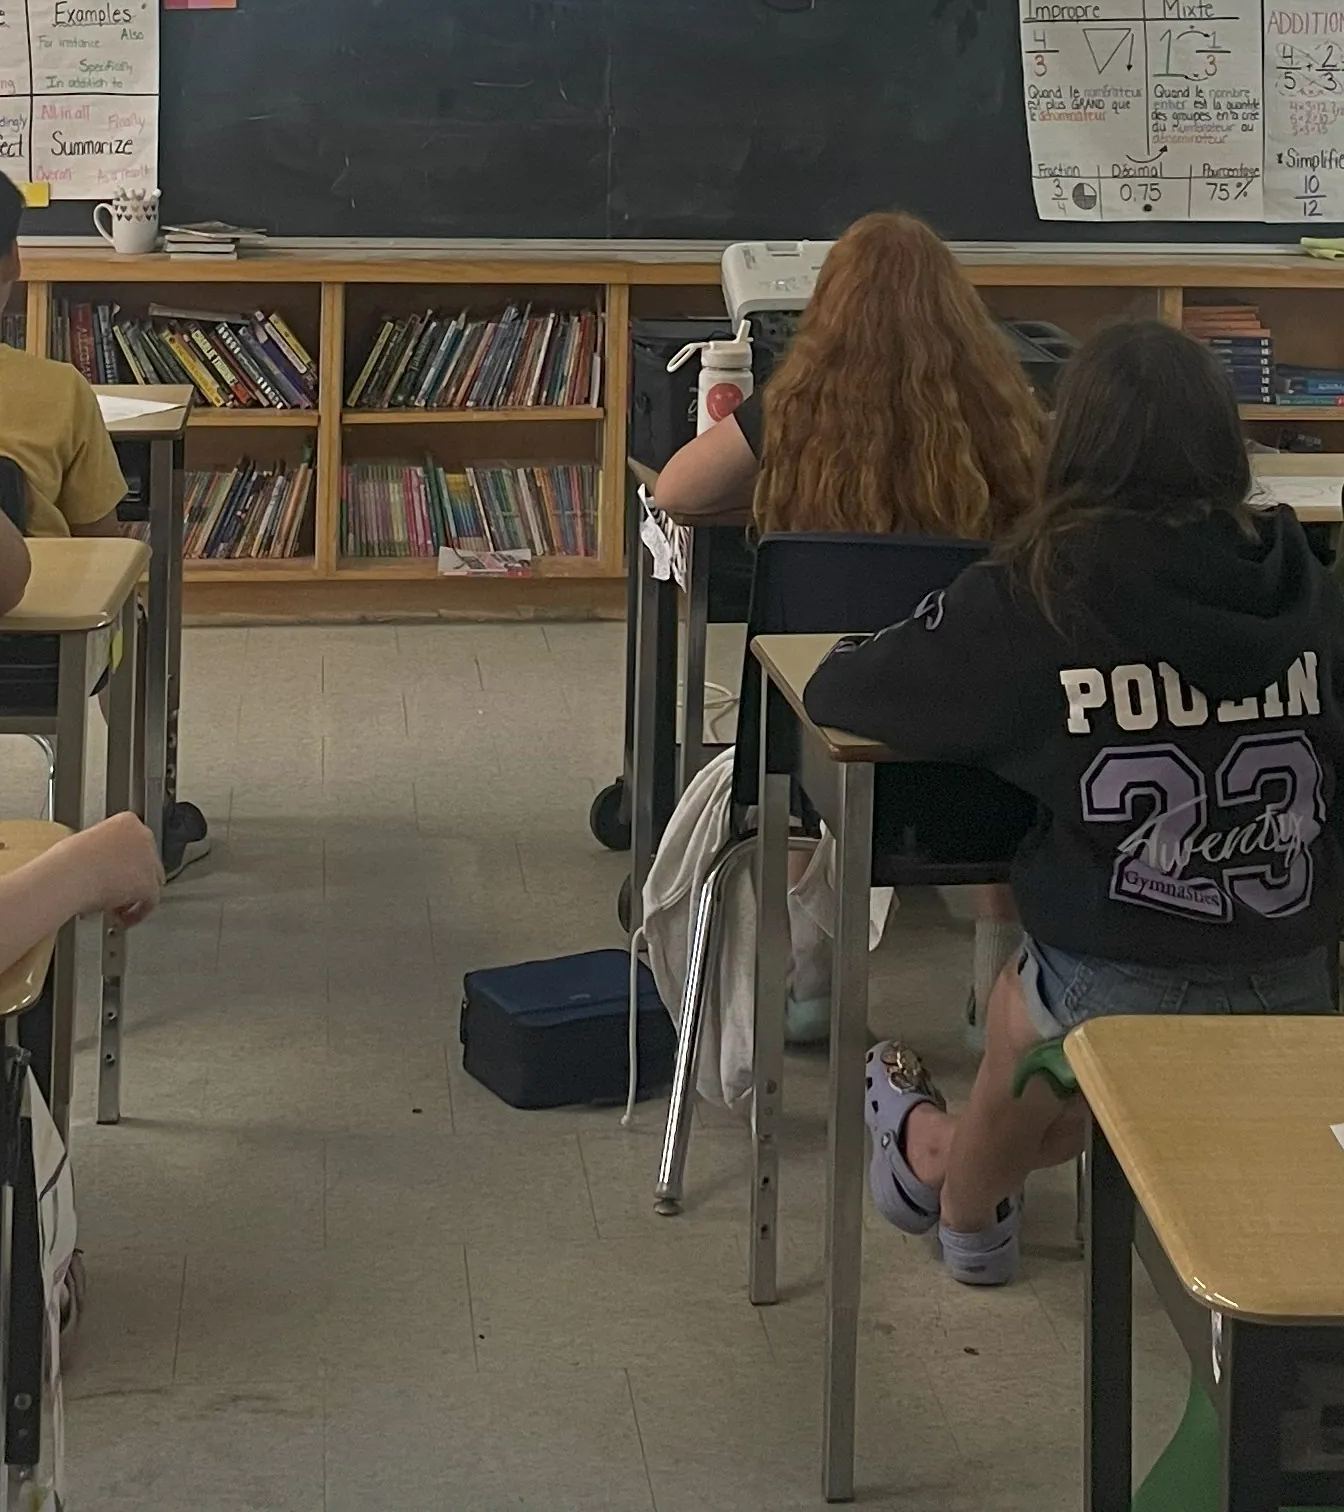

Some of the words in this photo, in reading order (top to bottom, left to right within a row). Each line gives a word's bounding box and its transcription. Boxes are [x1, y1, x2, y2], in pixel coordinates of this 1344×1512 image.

[53, 1, 133, 28] Examples
[50, 130, 134, 157] Summarize
[1079, 730, 1327, 924] 23
[1123, 868, 1221, 908] Gymnastics
